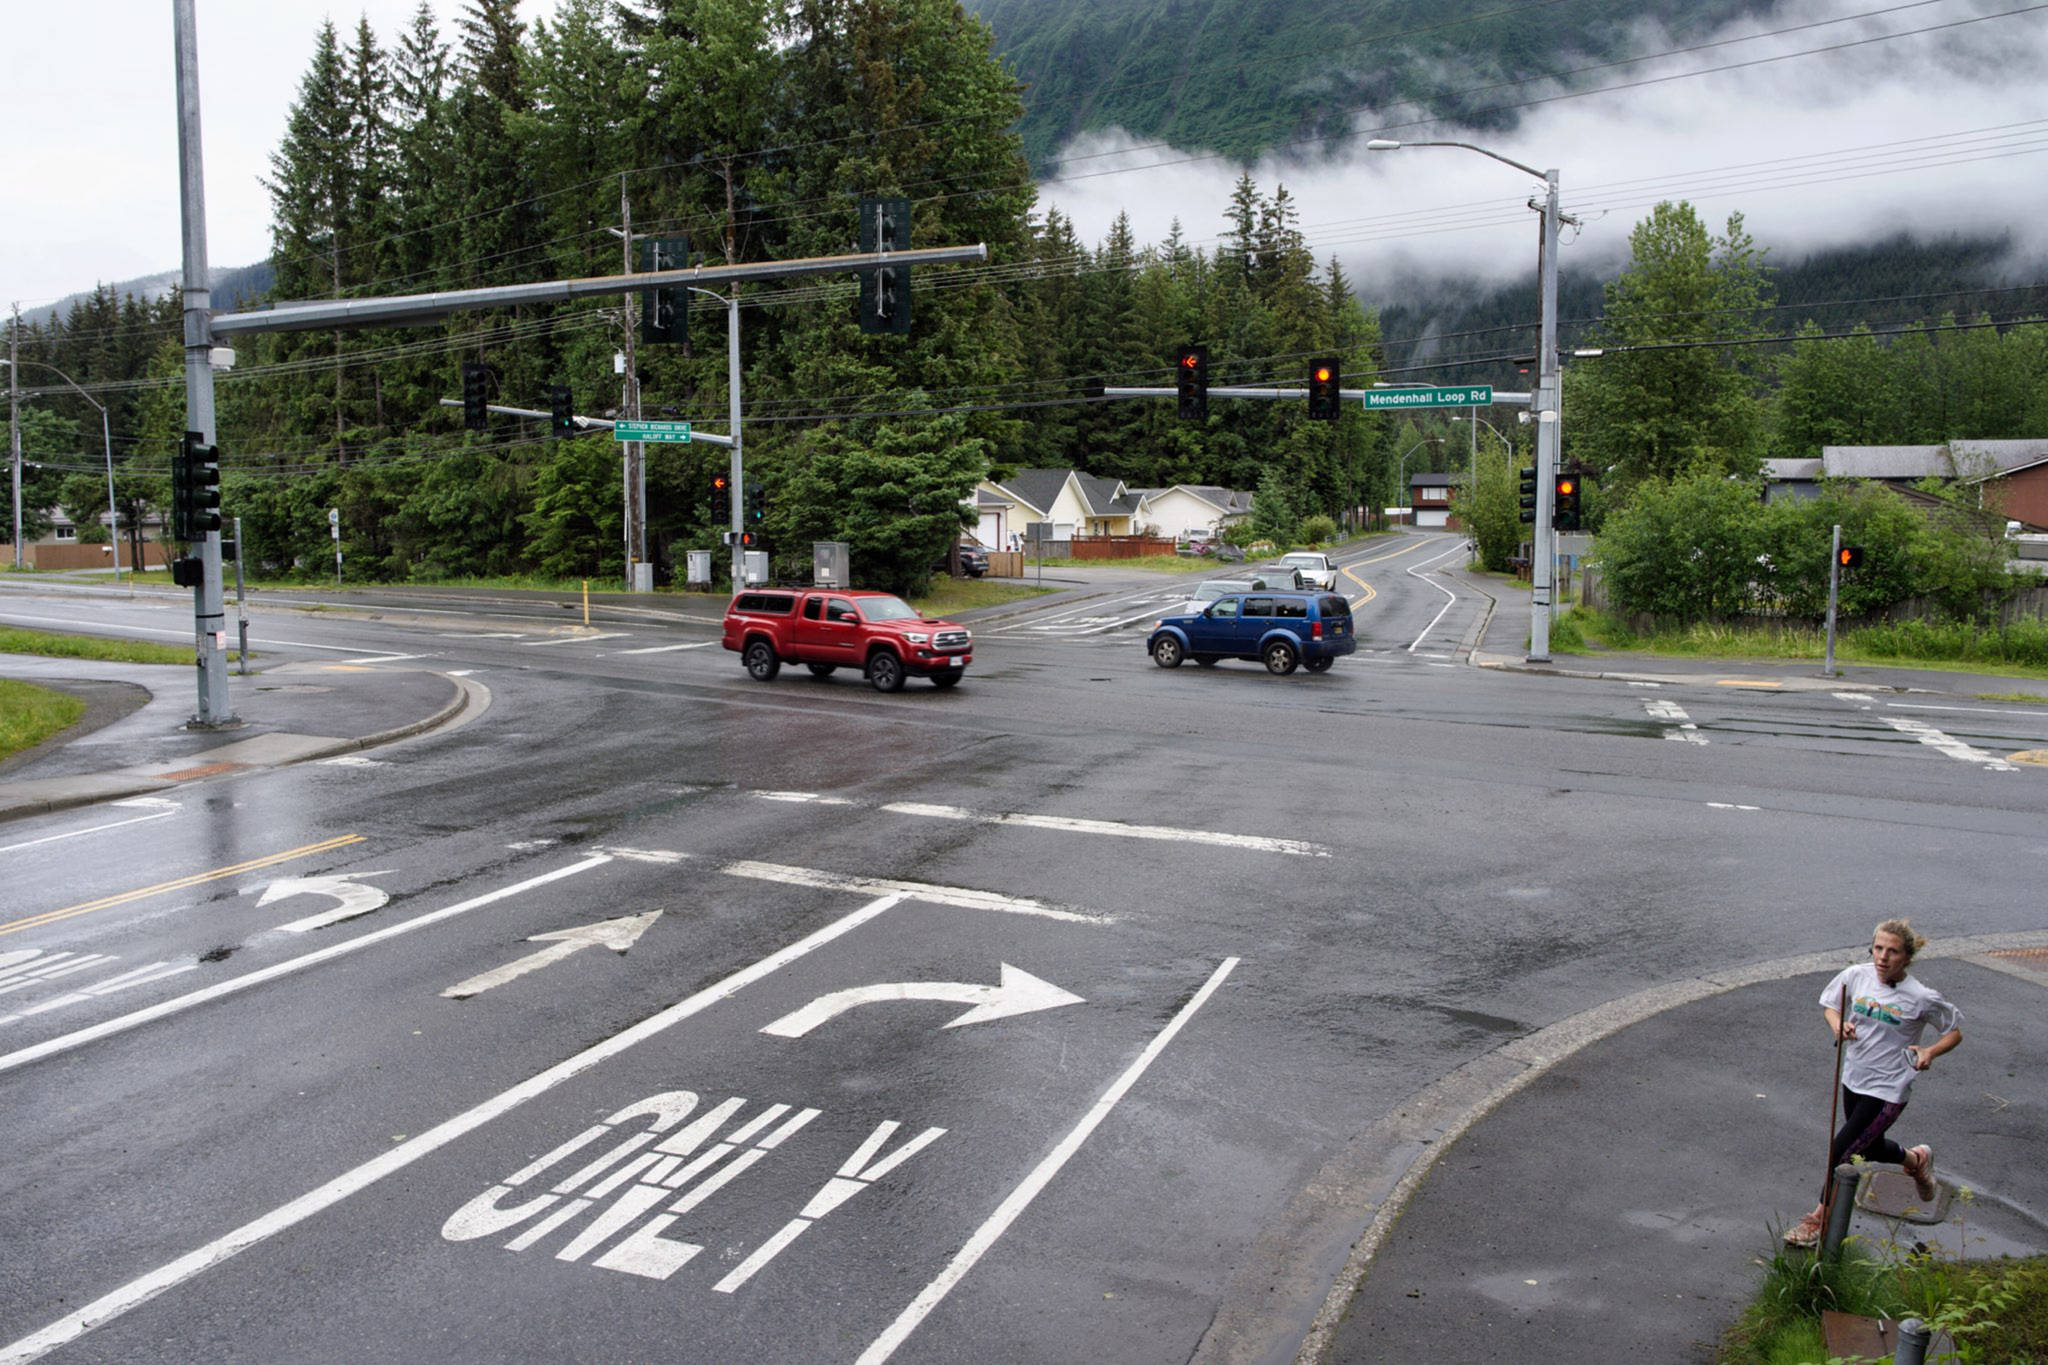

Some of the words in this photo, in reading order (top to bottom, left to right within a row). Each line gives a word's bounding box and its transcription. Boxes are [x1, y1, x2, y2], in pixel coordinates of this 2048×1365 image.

[1370, 393, 1433, 405] Mendenhall
[1437, 392, 1465, 404] Loop
[1470, 390, 1486, 401] Rd
[441, 1090, 949, 1295] ONLY
